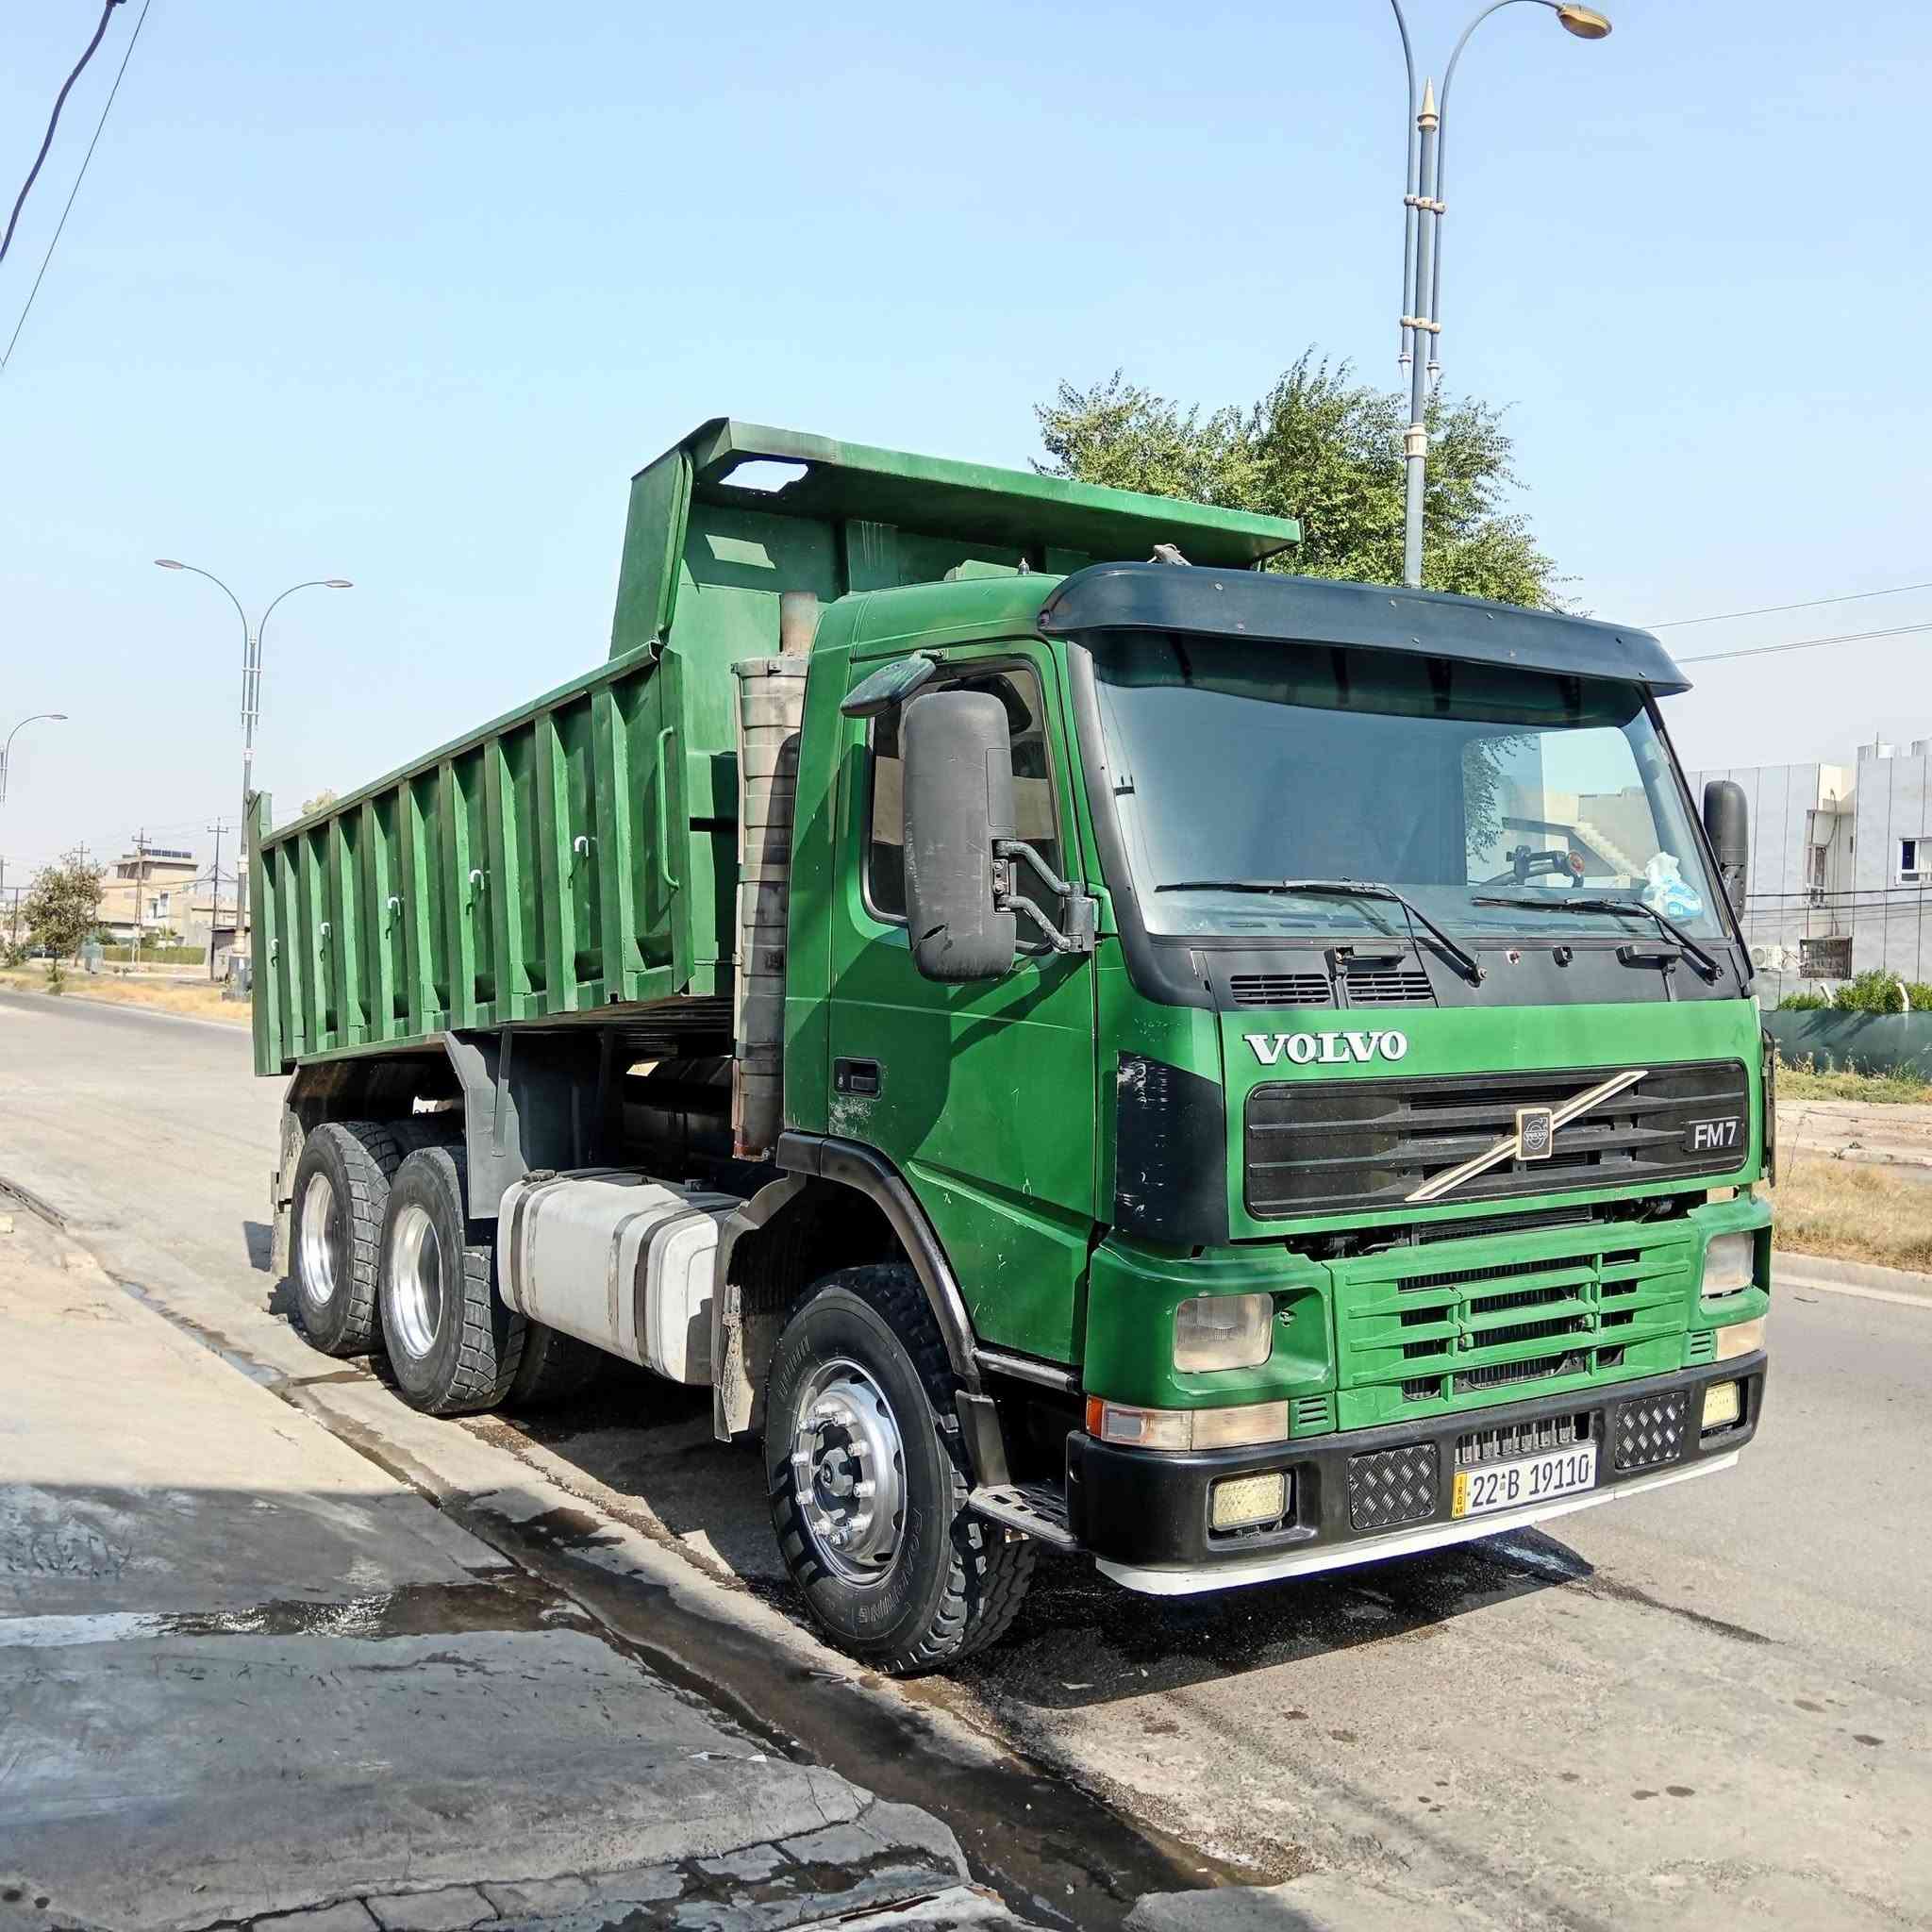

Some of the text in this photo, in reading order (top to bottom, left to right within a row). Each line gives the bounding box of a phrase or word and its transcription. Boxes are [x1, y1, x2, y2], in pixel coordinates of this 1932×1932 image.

[1242, 1030, 1407, 1064] VOLVO
[1694, 1121, 1737, 1149] FM7
[1472, 1454, 1589, 1507] 22 B 19110
